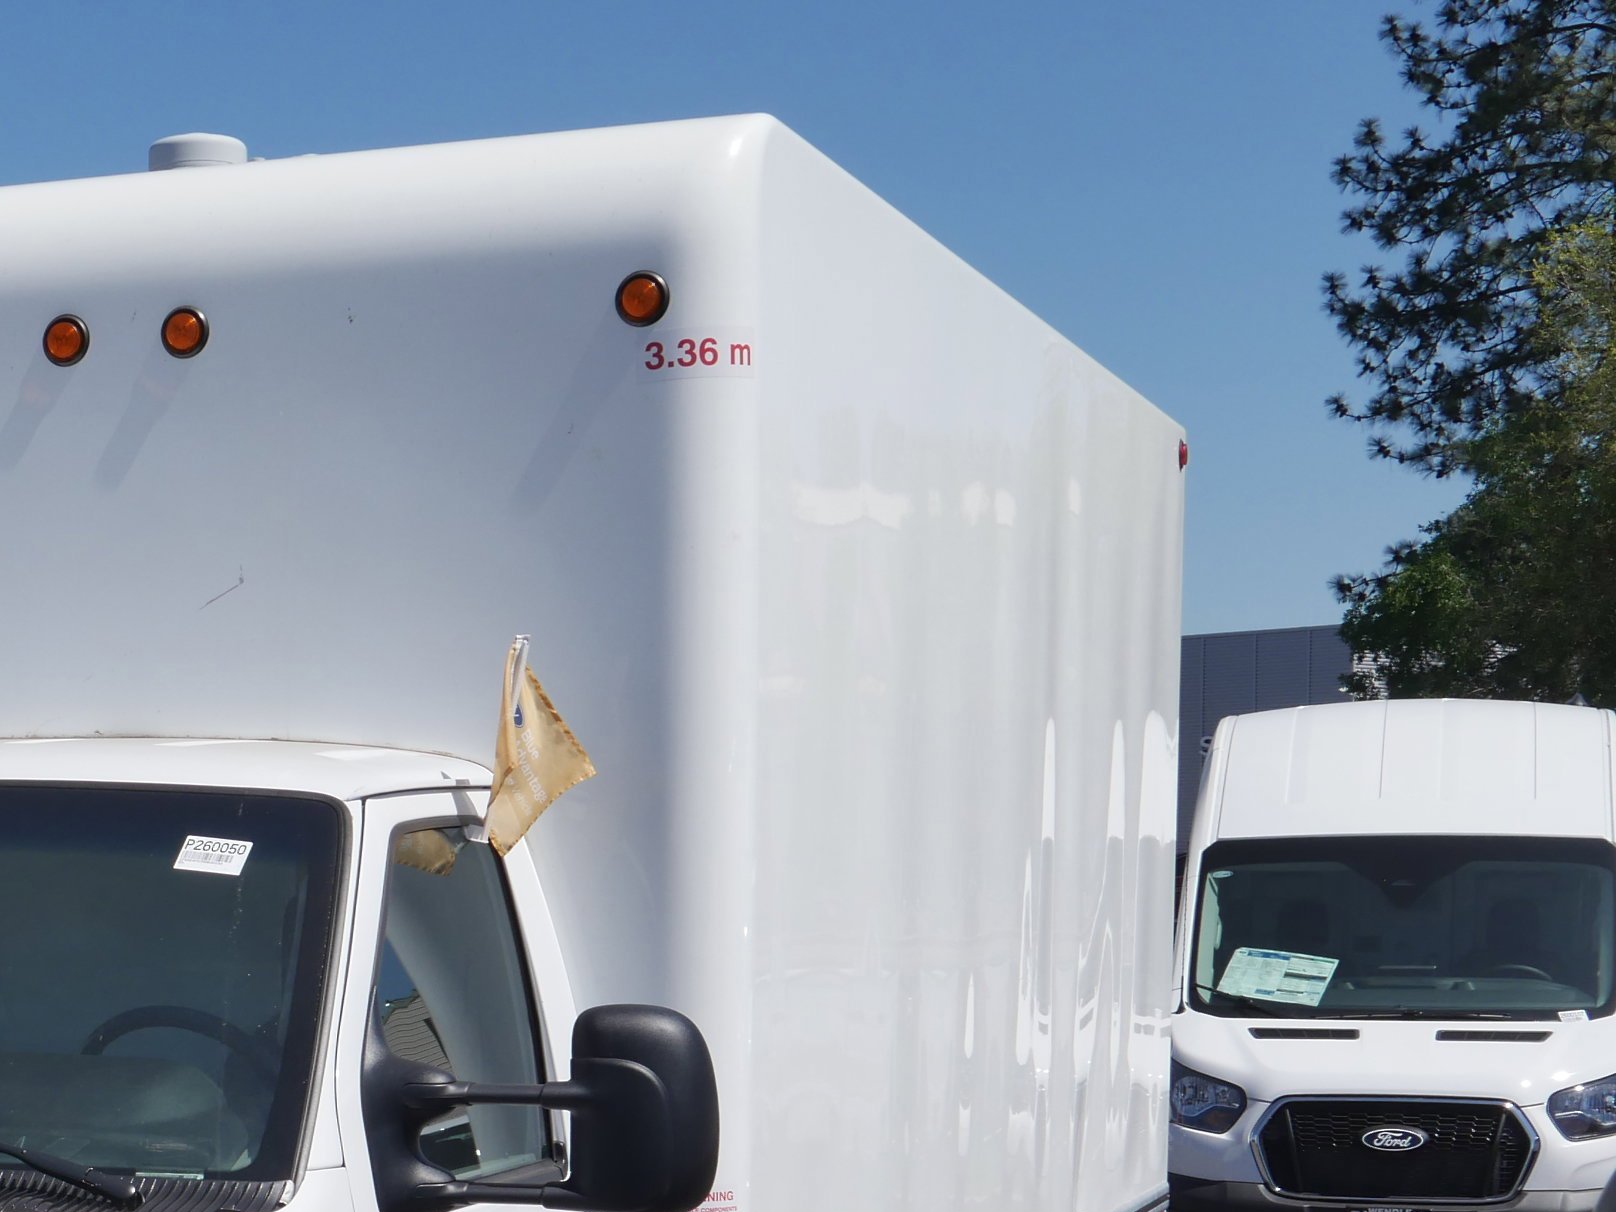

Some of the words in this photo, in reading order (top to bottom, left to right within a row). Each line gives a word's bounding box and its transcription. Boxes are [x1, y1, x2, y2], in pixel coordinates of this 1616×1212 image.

[644, 337, 719, 371] 3.36
[729, 343, 751, 366] m
[184, 838, 247, 856] P260050
[1373, 1131, 1412, 1147] Ford
[705, 1190, 734, 1202] NING
